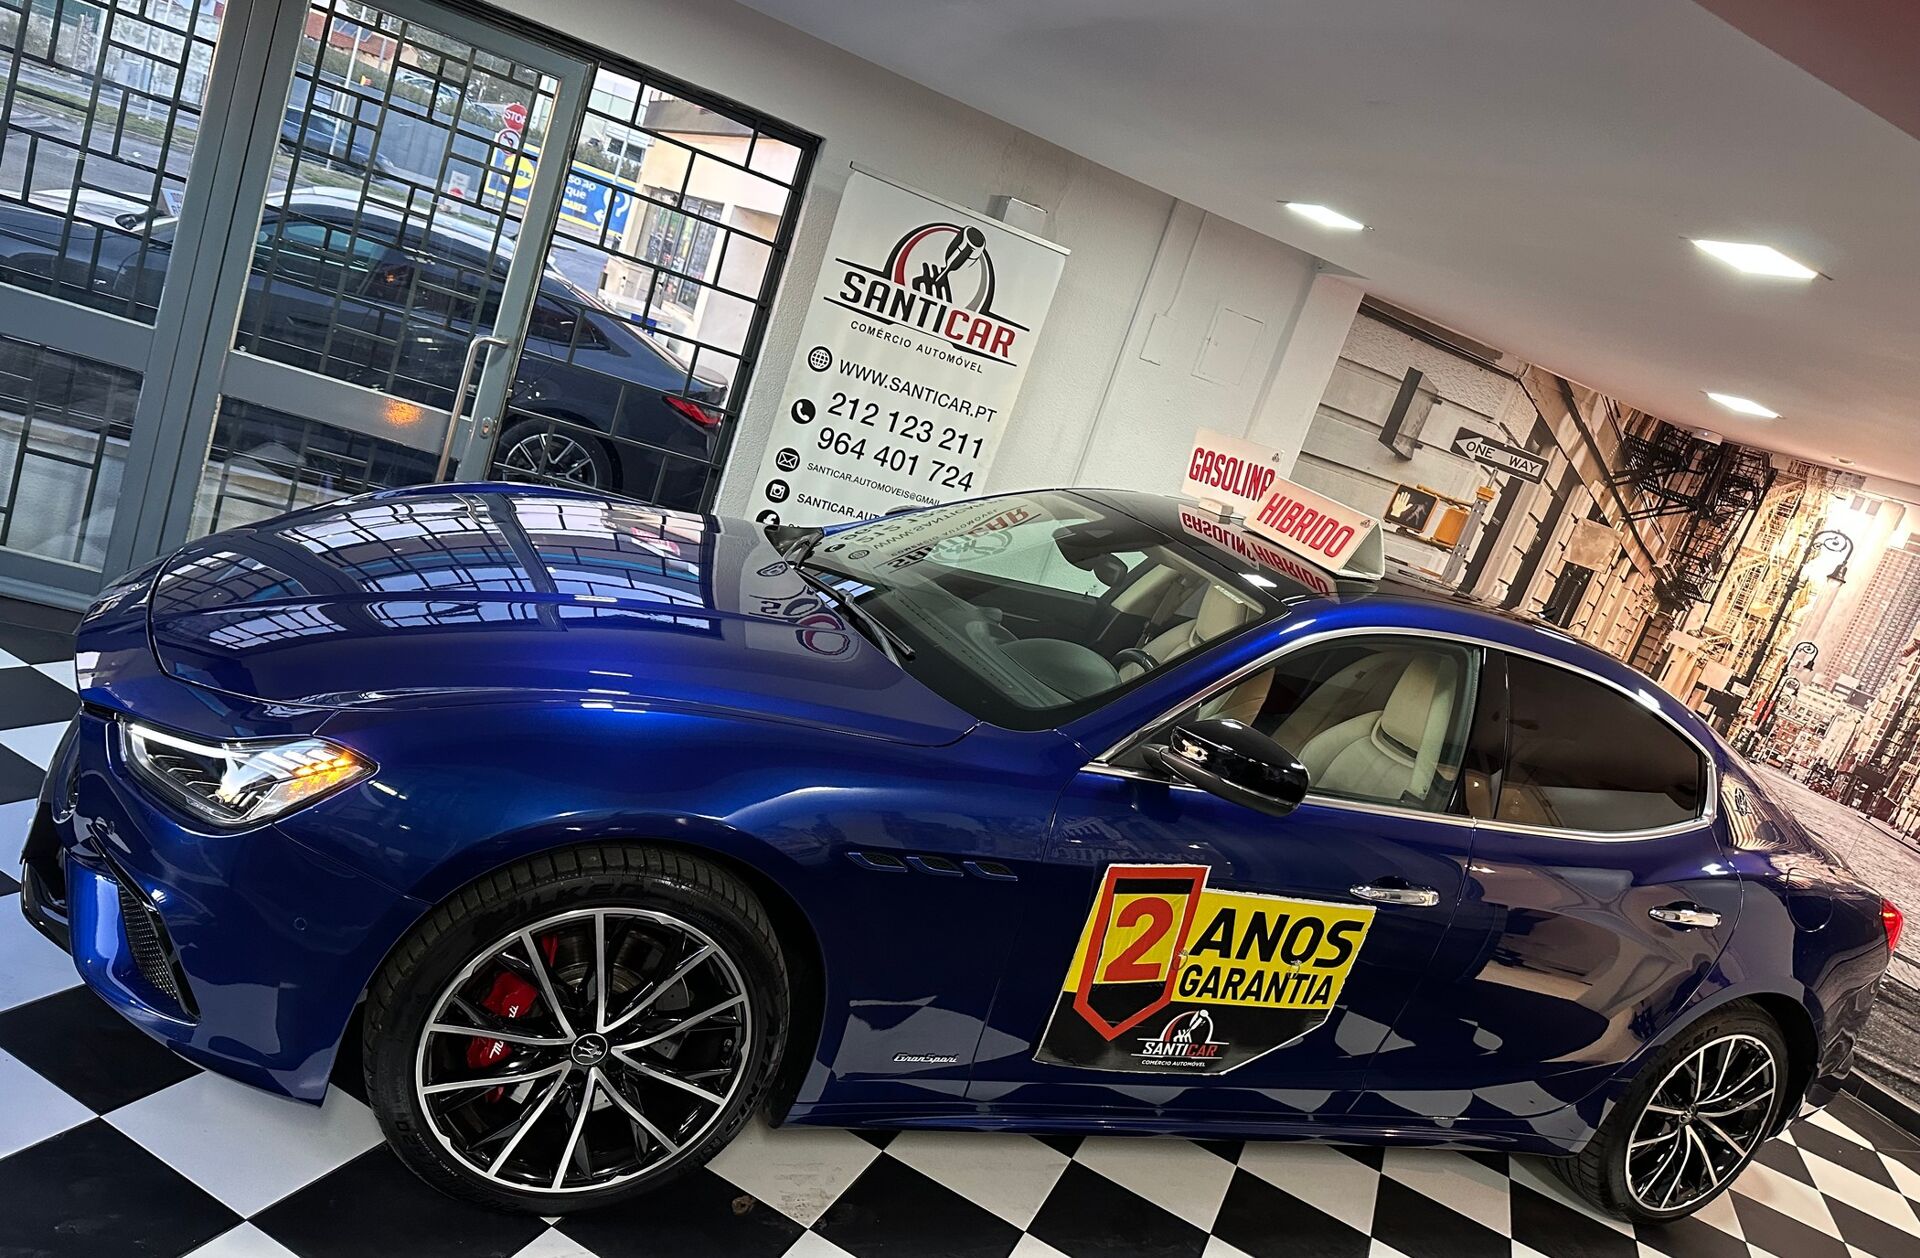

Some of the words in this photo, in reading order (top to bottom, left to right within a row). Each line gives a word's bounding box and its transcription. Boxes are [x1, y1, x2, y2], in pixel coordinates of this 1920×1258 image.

[839, 271, 1016, 359] SANTICAR
[850, 319, 913, 349] COMÉRCIO
[916, 343, 984, 374] AUTOMÓVEL
[838, 359, 998, 423] WWW.SANTICAR.PT
[828, 392, 880, 427] 212
[888, 411, 934, 444] 123
[938, 428, 985, 460] 211
[1466, 441, 1496, 459] ONE
[1509, 456, 1539, 474] WAY
[817, 426, 867, 461] 964
[873, 445, 920, 477] 401
[928, 461, 976, 493] 724
[1256, 492, 1355, 559] HIBRIDO
[1102, 896, 1175, 982] 2
[1188, 907, 1366, 970] ANOS
[1178, 964, 1334, 1006] GARANTIA
[1142, 1041, 1219, 1057] SANTICAR
